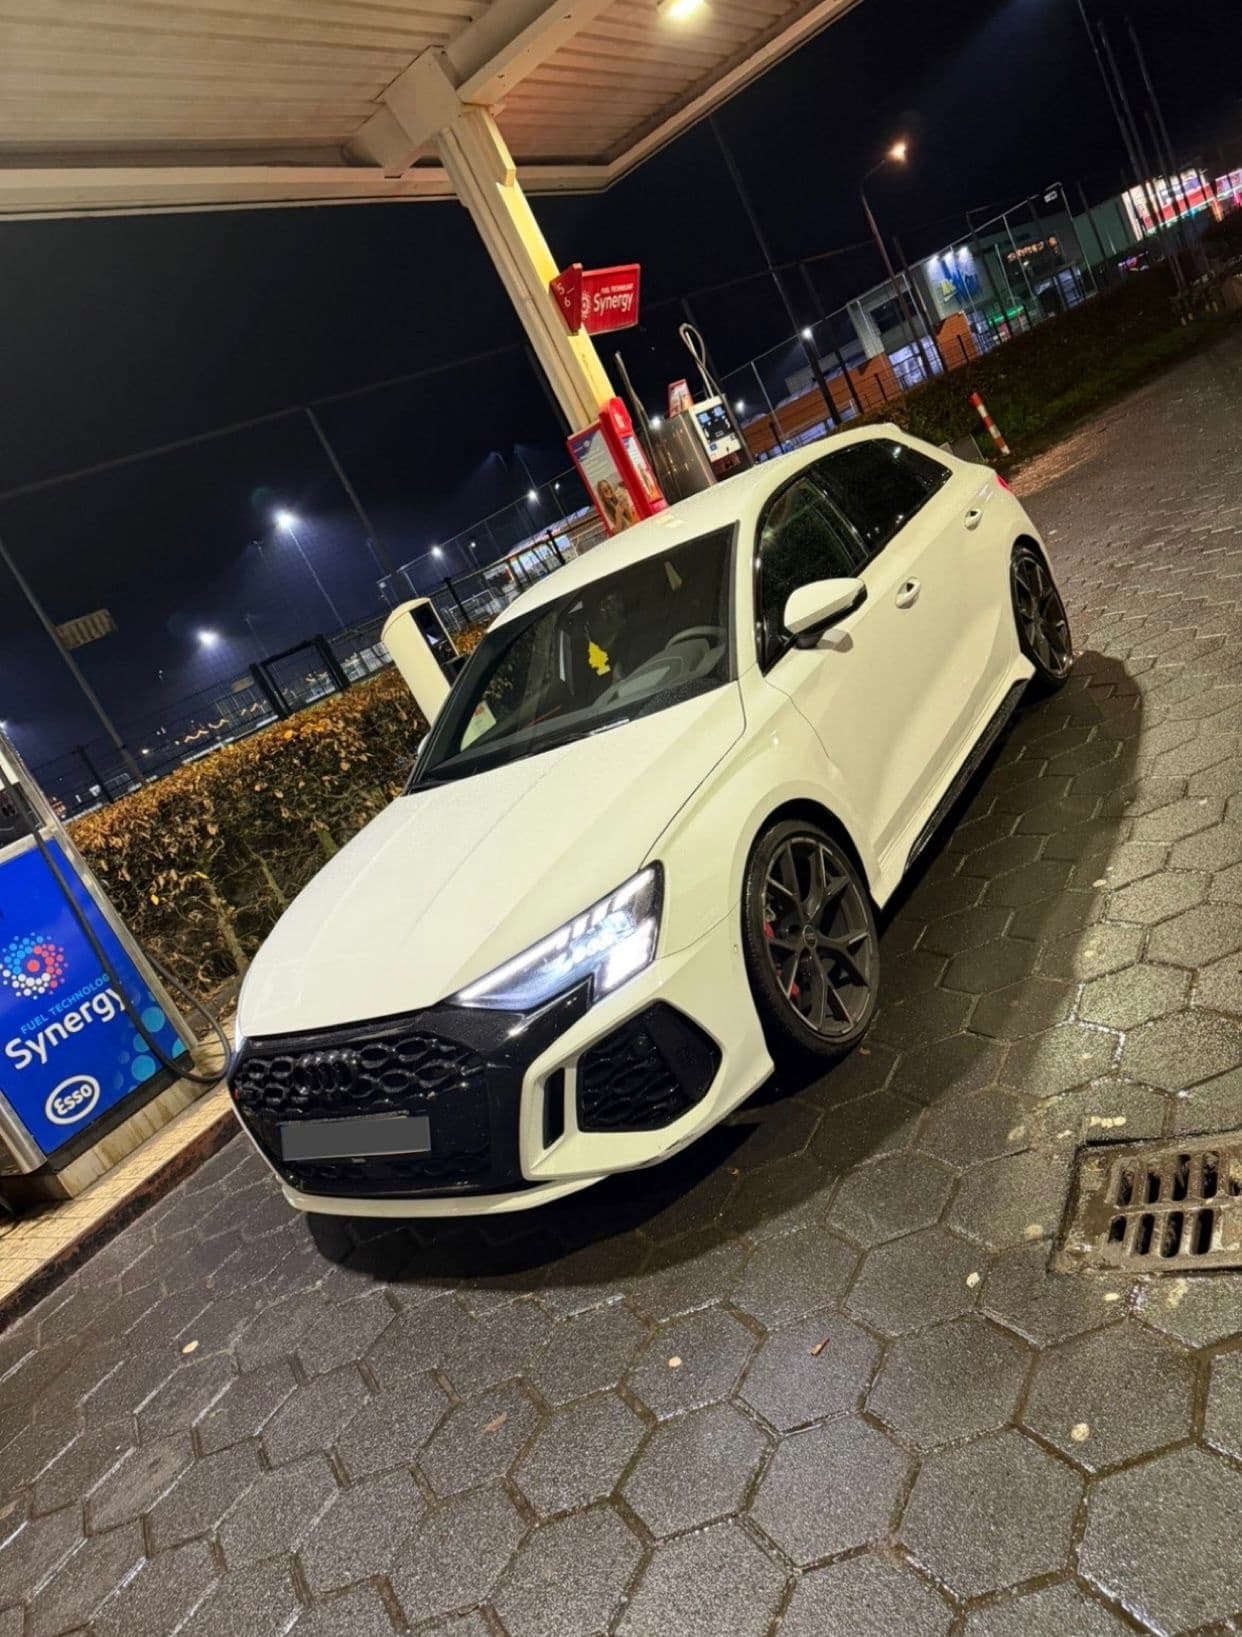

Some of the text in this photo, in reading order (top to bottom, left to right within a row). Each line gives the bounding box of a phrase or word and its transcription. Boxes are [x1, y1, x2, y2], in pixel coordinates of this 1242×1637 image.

[593, 291, 635, 317] Synergy
[20, 973, 110, 1035] FUEL TECHNOLOG
[4, 985, 127, 1071] Synergy
[53, 1086, 92, 1116] Esso
